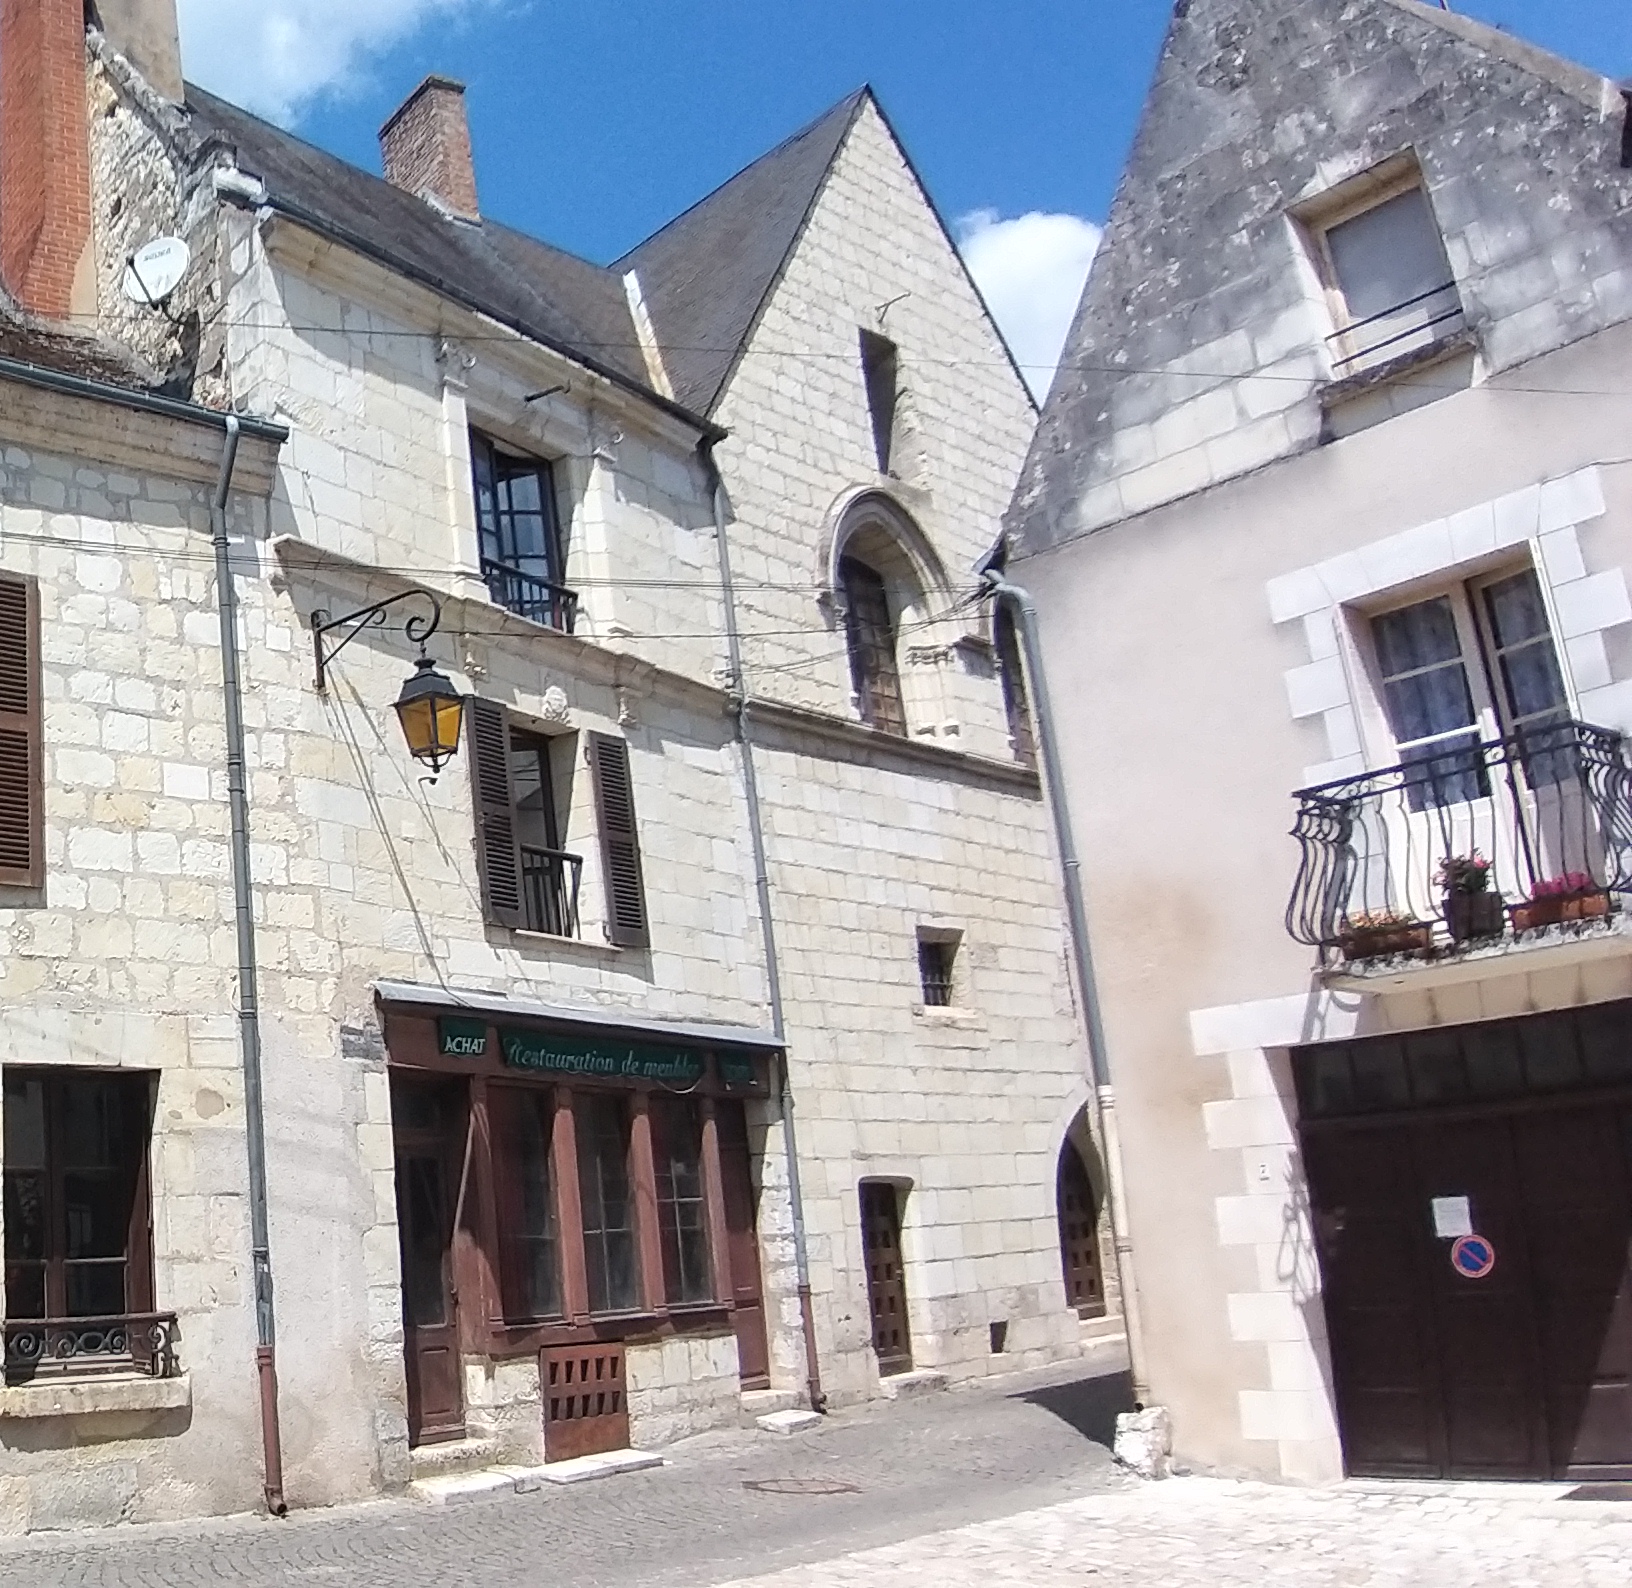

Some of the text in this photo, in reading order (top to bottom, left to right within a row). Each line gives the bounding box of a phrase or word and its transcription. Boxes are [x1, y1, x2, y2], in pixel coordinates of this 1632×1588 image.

[444, 1035, 486, 1054] ACHAT
[506, 1037, 614, 1072] Restauration
[621, 1050, 640, 1074] de
